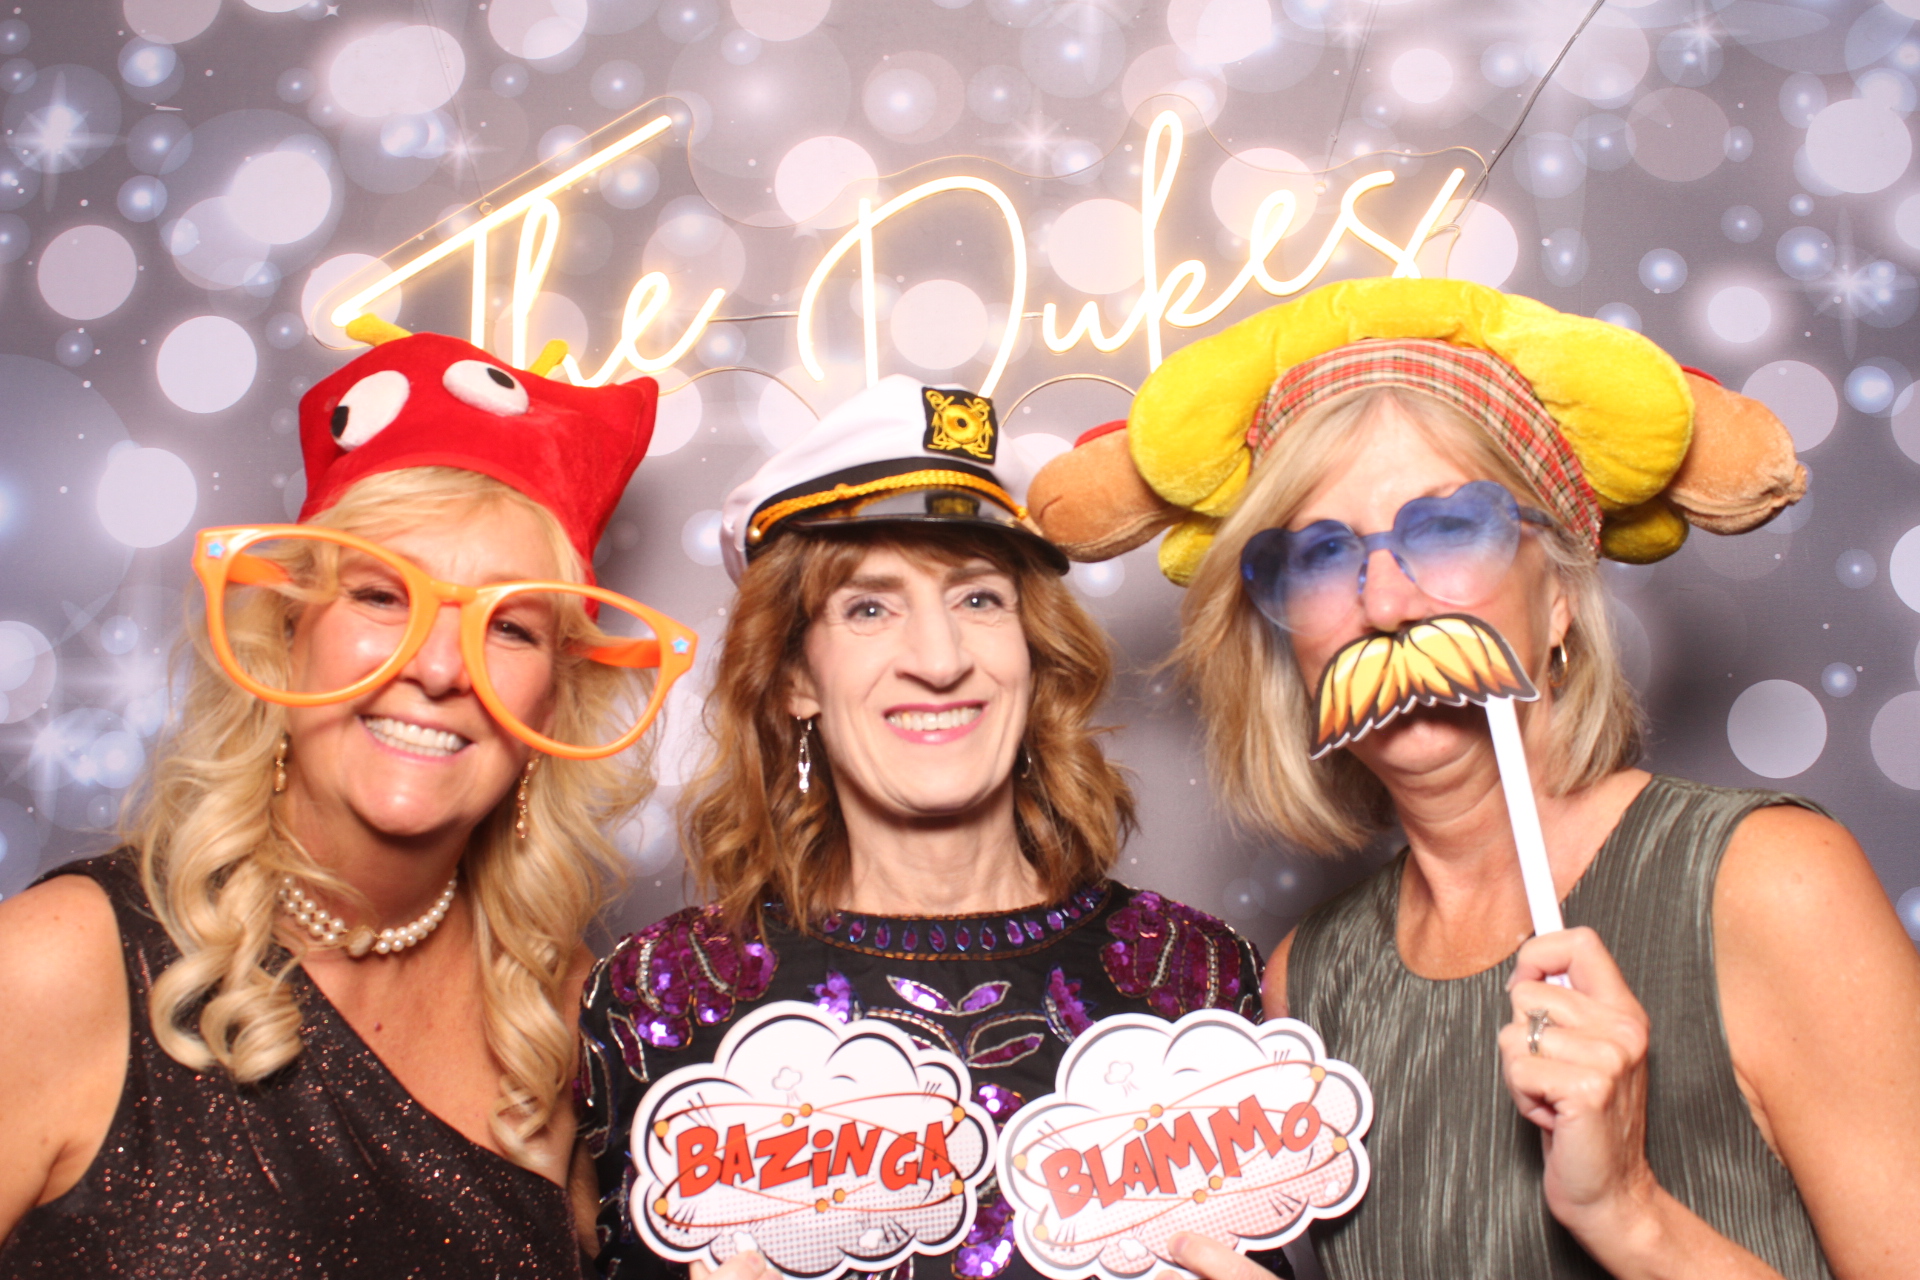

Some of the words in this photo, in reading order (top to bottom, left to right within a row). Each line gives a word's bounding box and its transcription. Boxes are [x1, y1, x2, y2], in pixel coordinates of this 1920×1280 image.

[331, 114, 727, 388] The
[797, 109, 1466, 399] Dukes
[1040, 1094, 1322, 1220] BLAMMO
